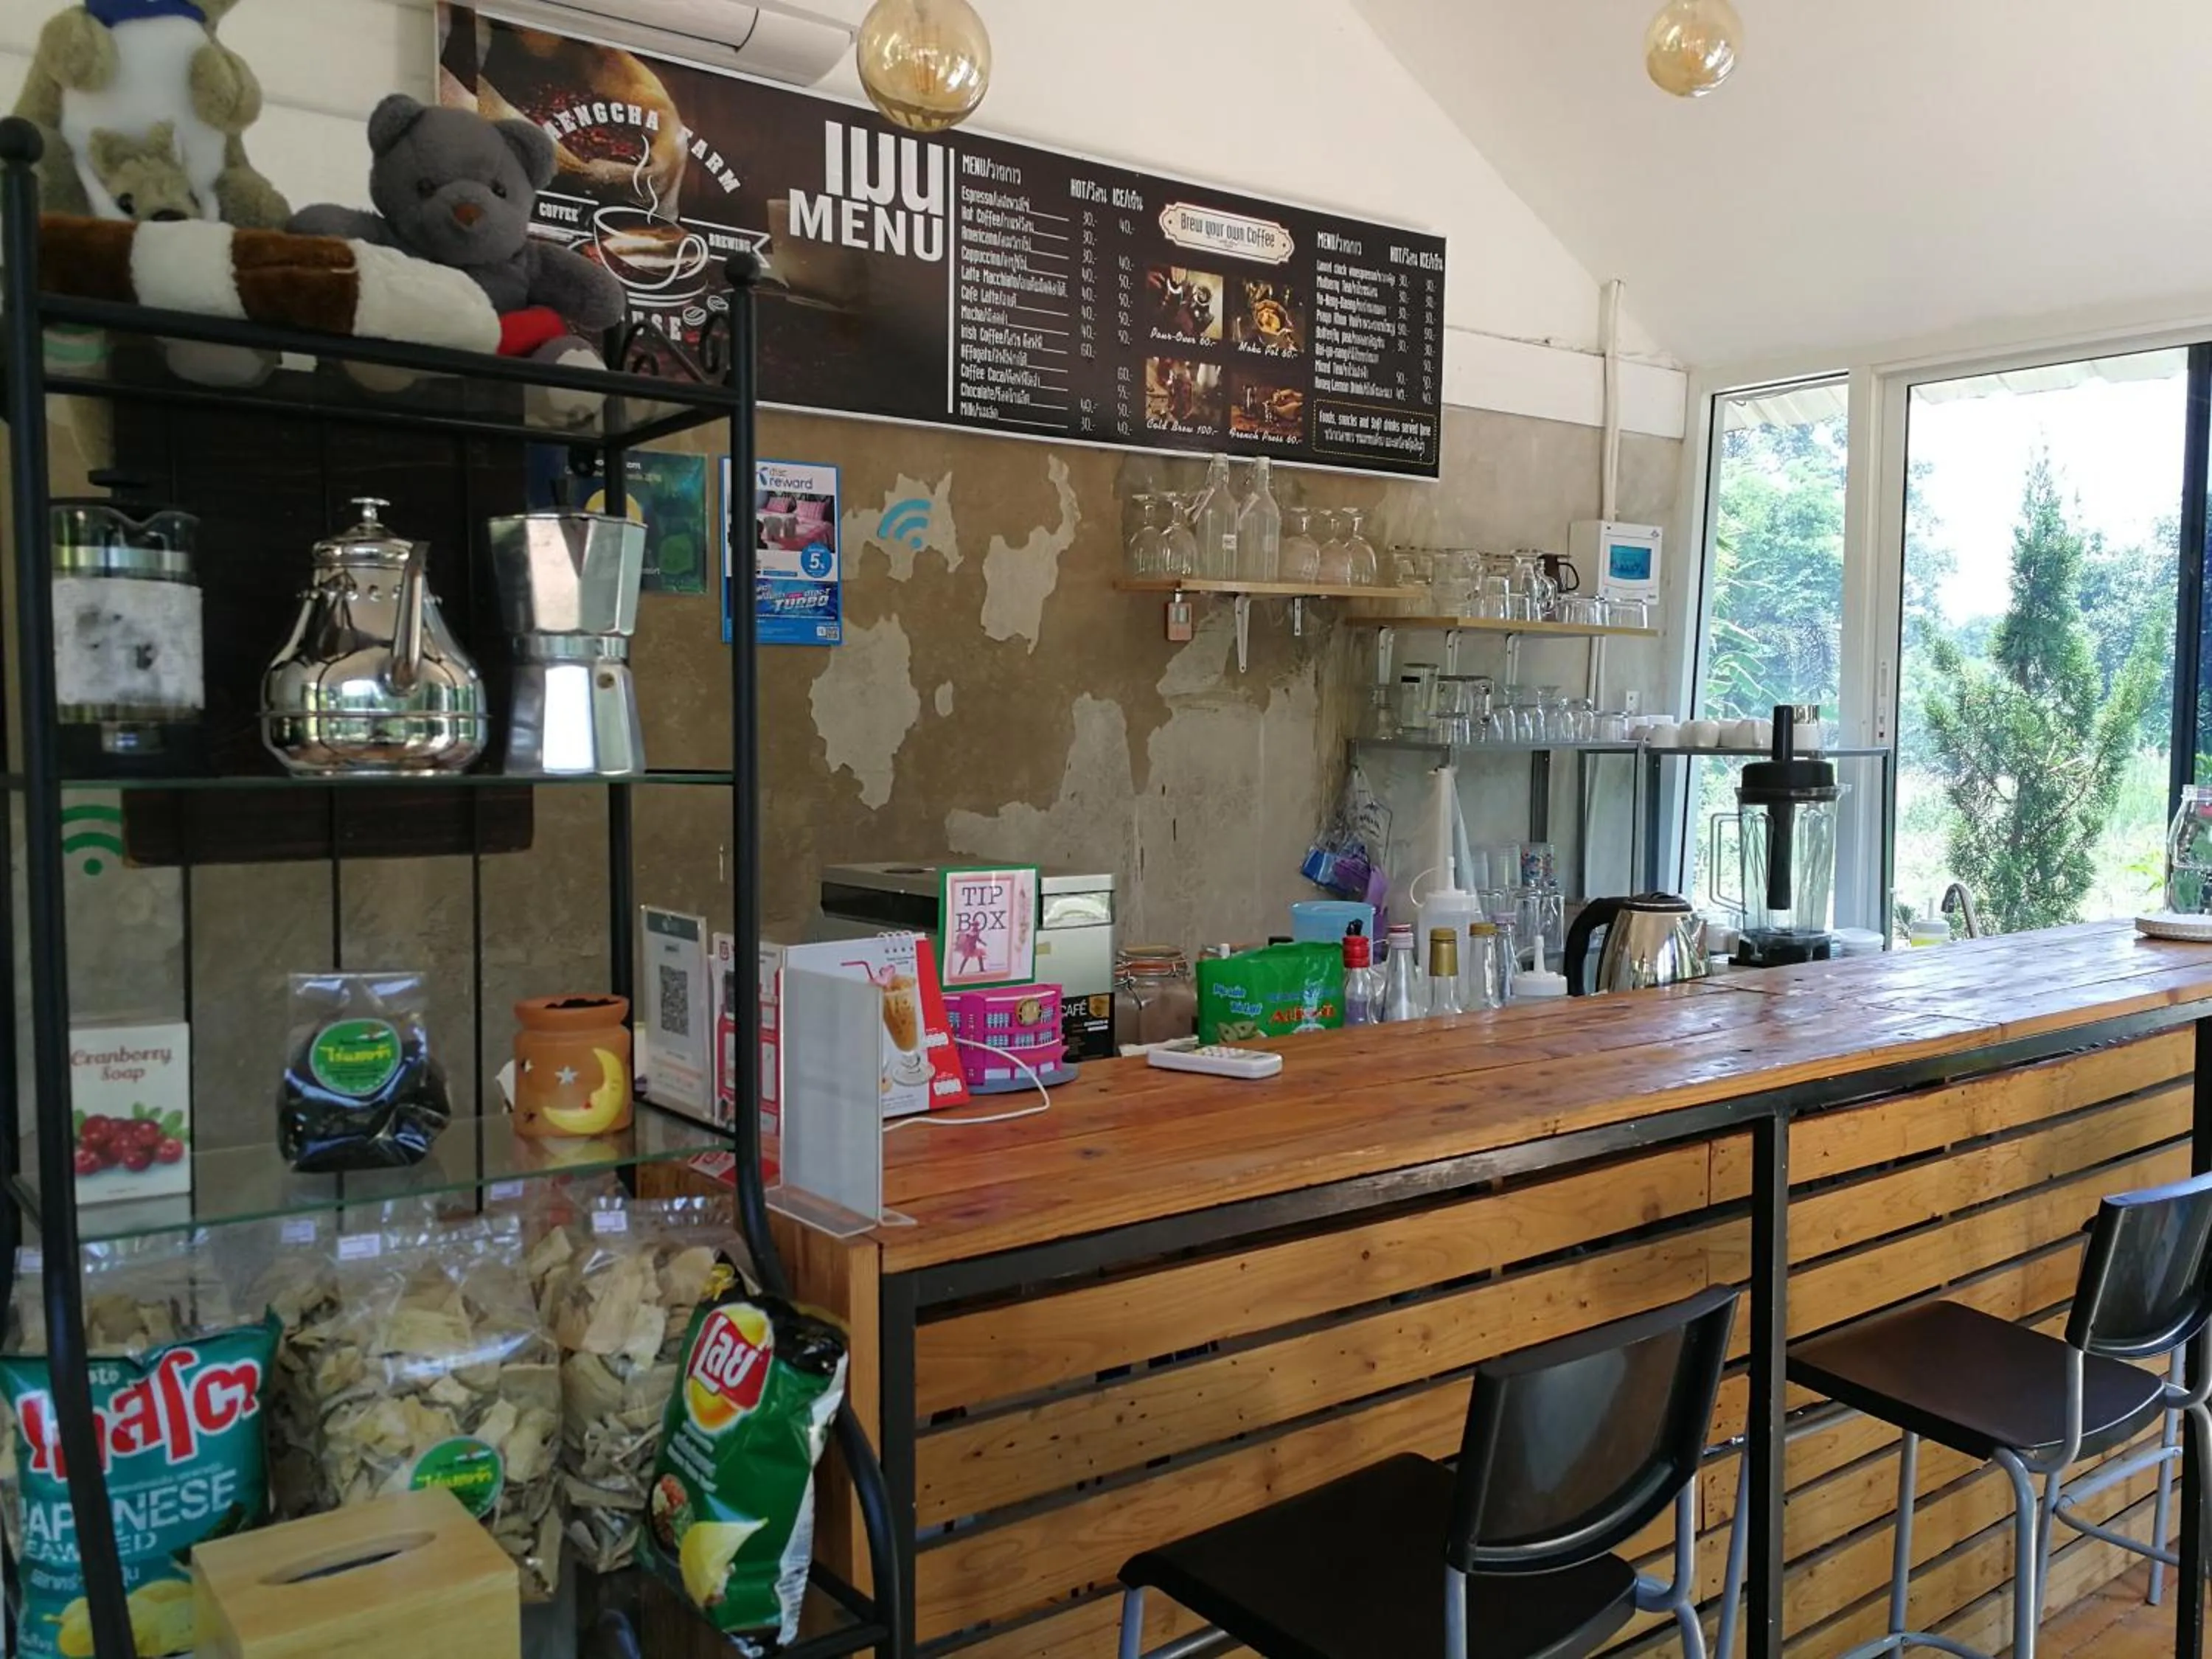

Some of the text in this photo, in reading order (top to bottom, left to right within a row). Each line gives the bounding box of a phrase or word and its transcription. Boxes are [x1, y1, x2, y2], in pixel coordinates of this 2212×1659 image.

[539, 202, 579, 222] COFFEE
[789, 188, 943, 262] MENU
[1180, 213, 1275, 248] Brew your own Coffee
[709, 233, 751, 253] BREWING
[769, 477, 813, 490] reward
[774, 595, 830, 613] TURBO
[961, 886, 1003, 906] TIP
[956, 911, 1006, 933] BOX
[70, 1046, 172, 1067] Cranberry
[101, 1068, 145, 1082] Soap
[20, 1470, 237, 1541] JAPNESE
